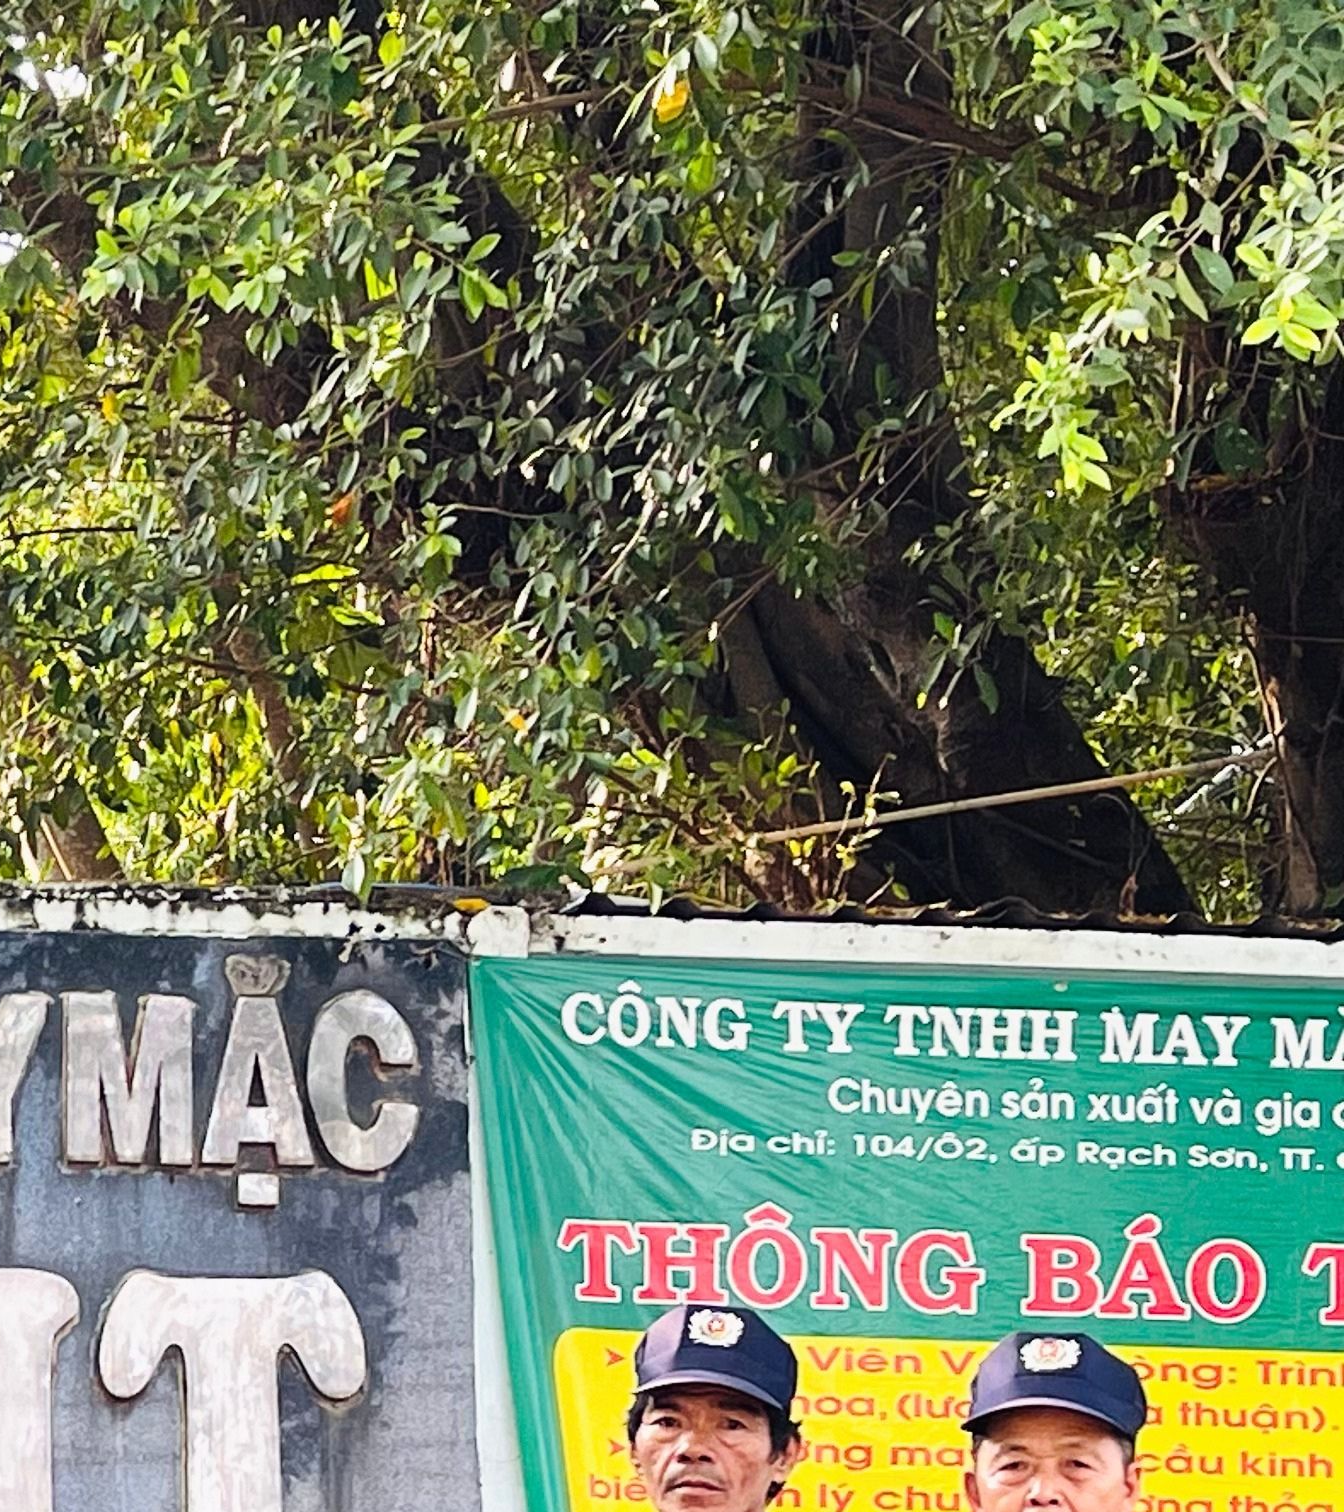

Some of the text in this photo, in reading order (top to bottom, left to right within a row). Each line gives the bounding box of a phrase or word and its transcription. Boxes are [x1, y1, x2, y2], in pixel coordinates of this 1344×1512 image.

[561, 979, 751, 1052] CÔNG
[773, 1000, 865, 1054] TY
[884, 1003, 1078, 1062] TNHH
[1099, 1008, 1251, 1067] MAY
[828, 1077, 990, 1123] Chuyên
[1001, 1078, 1075, 1121] sản
[1087, 1083, 1179, 1124] xuất
[1190, 1089, 1241, 1125] và
[1255, 1093, 1321, 1136] gia
[691, 1128, 756, 1157] Địa
[767, 1130, 836, 1156] chỉ:
[1010, 1137, 1066, 1167] ấp
[1077, 1142, 1177, 1171] Rạch
[1188, 1144, 1269, 1172] Sơn,
[1280, 1148, 1325, 1171] TT.
[558, 1201, 986, 1315] THÔNG
[1020, 1213, 1266, 1324] BÁO
[807, 1346, 922, 1374] Viên
[1256, 1360, 1344, 1387] Trìn
[1136, 1443, 1223, 1475] cầu
[1241, 1451, 1333, 1479] kinh
